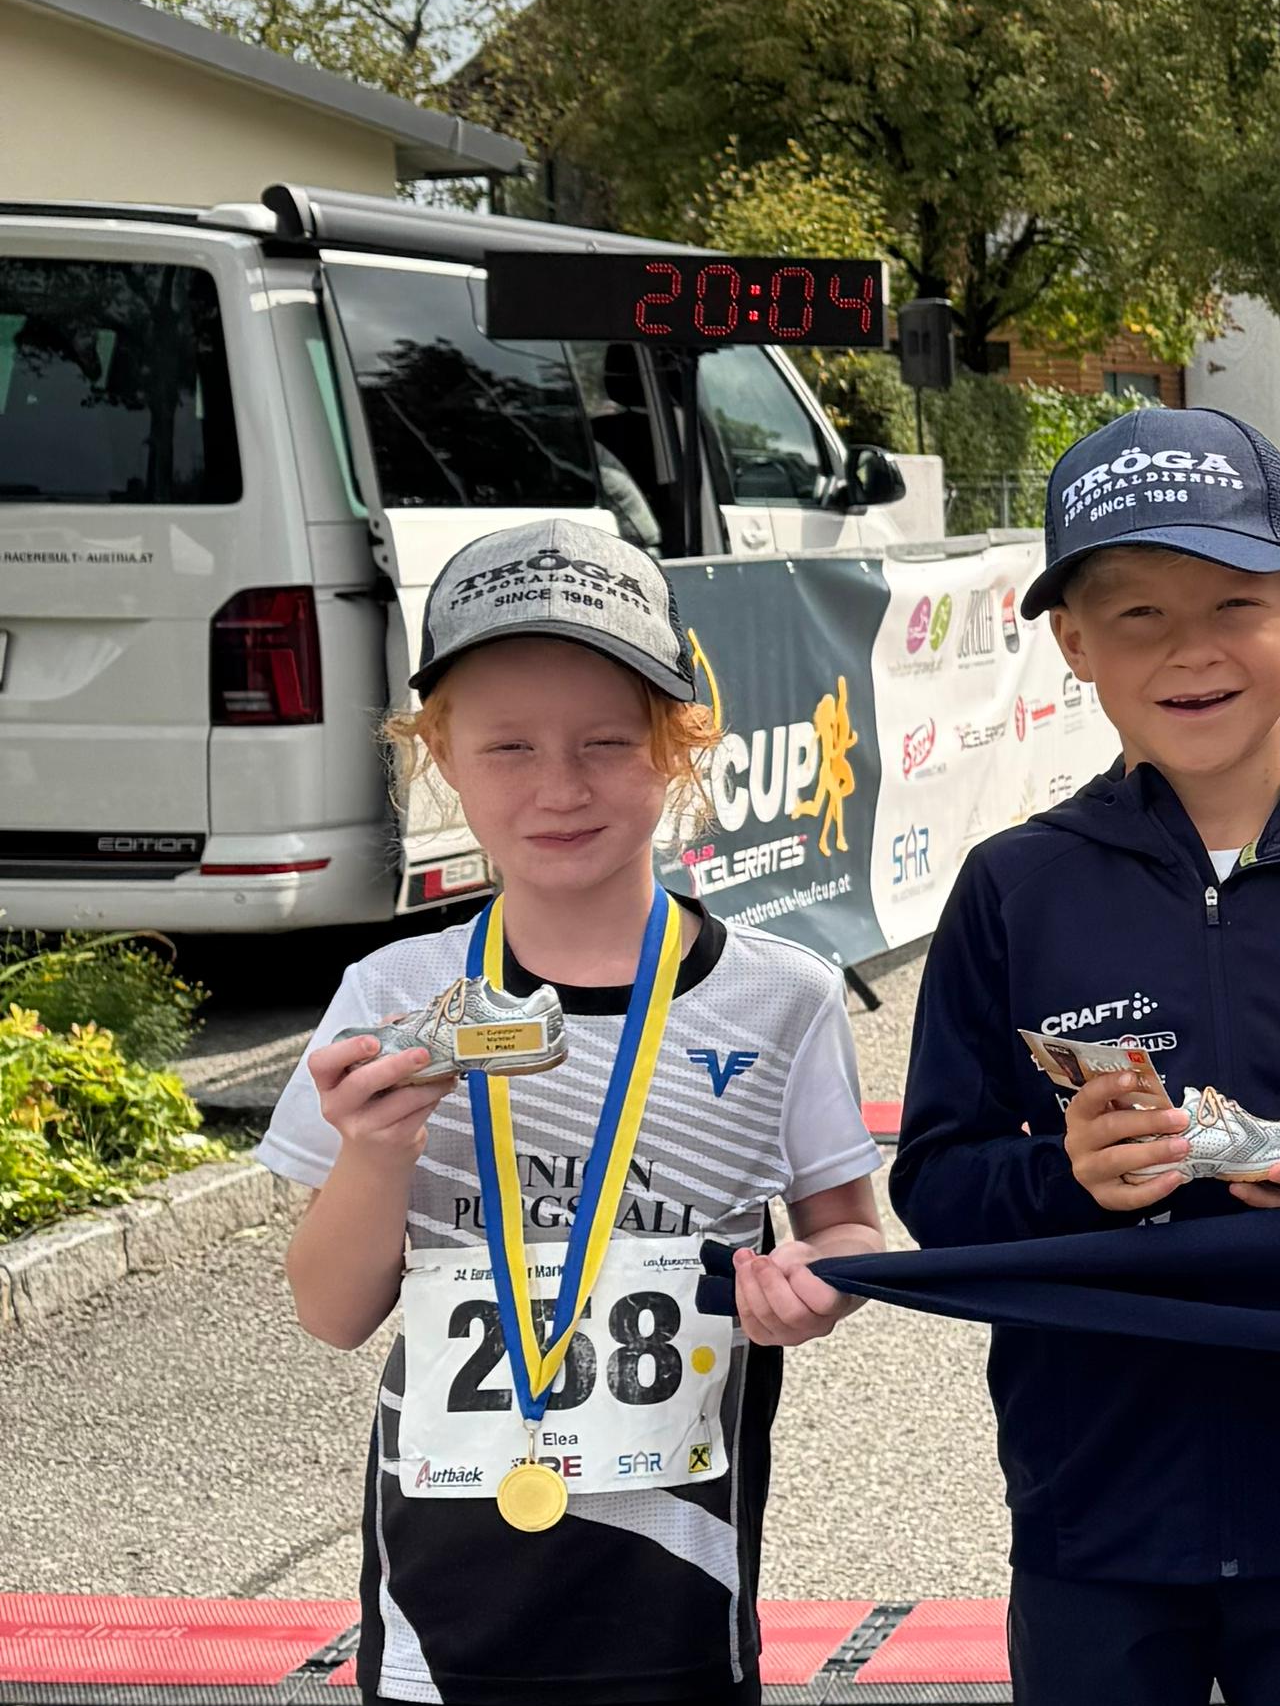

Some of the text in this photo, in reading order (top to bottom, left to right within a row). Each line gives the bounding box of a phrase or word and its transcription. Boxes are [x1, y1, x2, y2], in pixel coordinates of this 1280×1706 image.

[634, 262, 873, 337] 20:04
[1061, 447, 1240, 510] TRÖGA
[1063, 471, 1245, 527] PERSONALDIENSTE
[1090, 489, 1188, 522] SINCE 1986
[453, 549, 650, 604] TRÖGA
[494, 589, 604, 610] SINCE 1986
[97, 836, 197, 853] EDITION
[892, 824, 931, 885] SAR
[1041, 999, 1130, 1036] CRAFT
[515, 1154, 656, 1193] NIN
[542, 1432, 578, 1446] Elea
[618, 1450, 663, 1475] SAR
